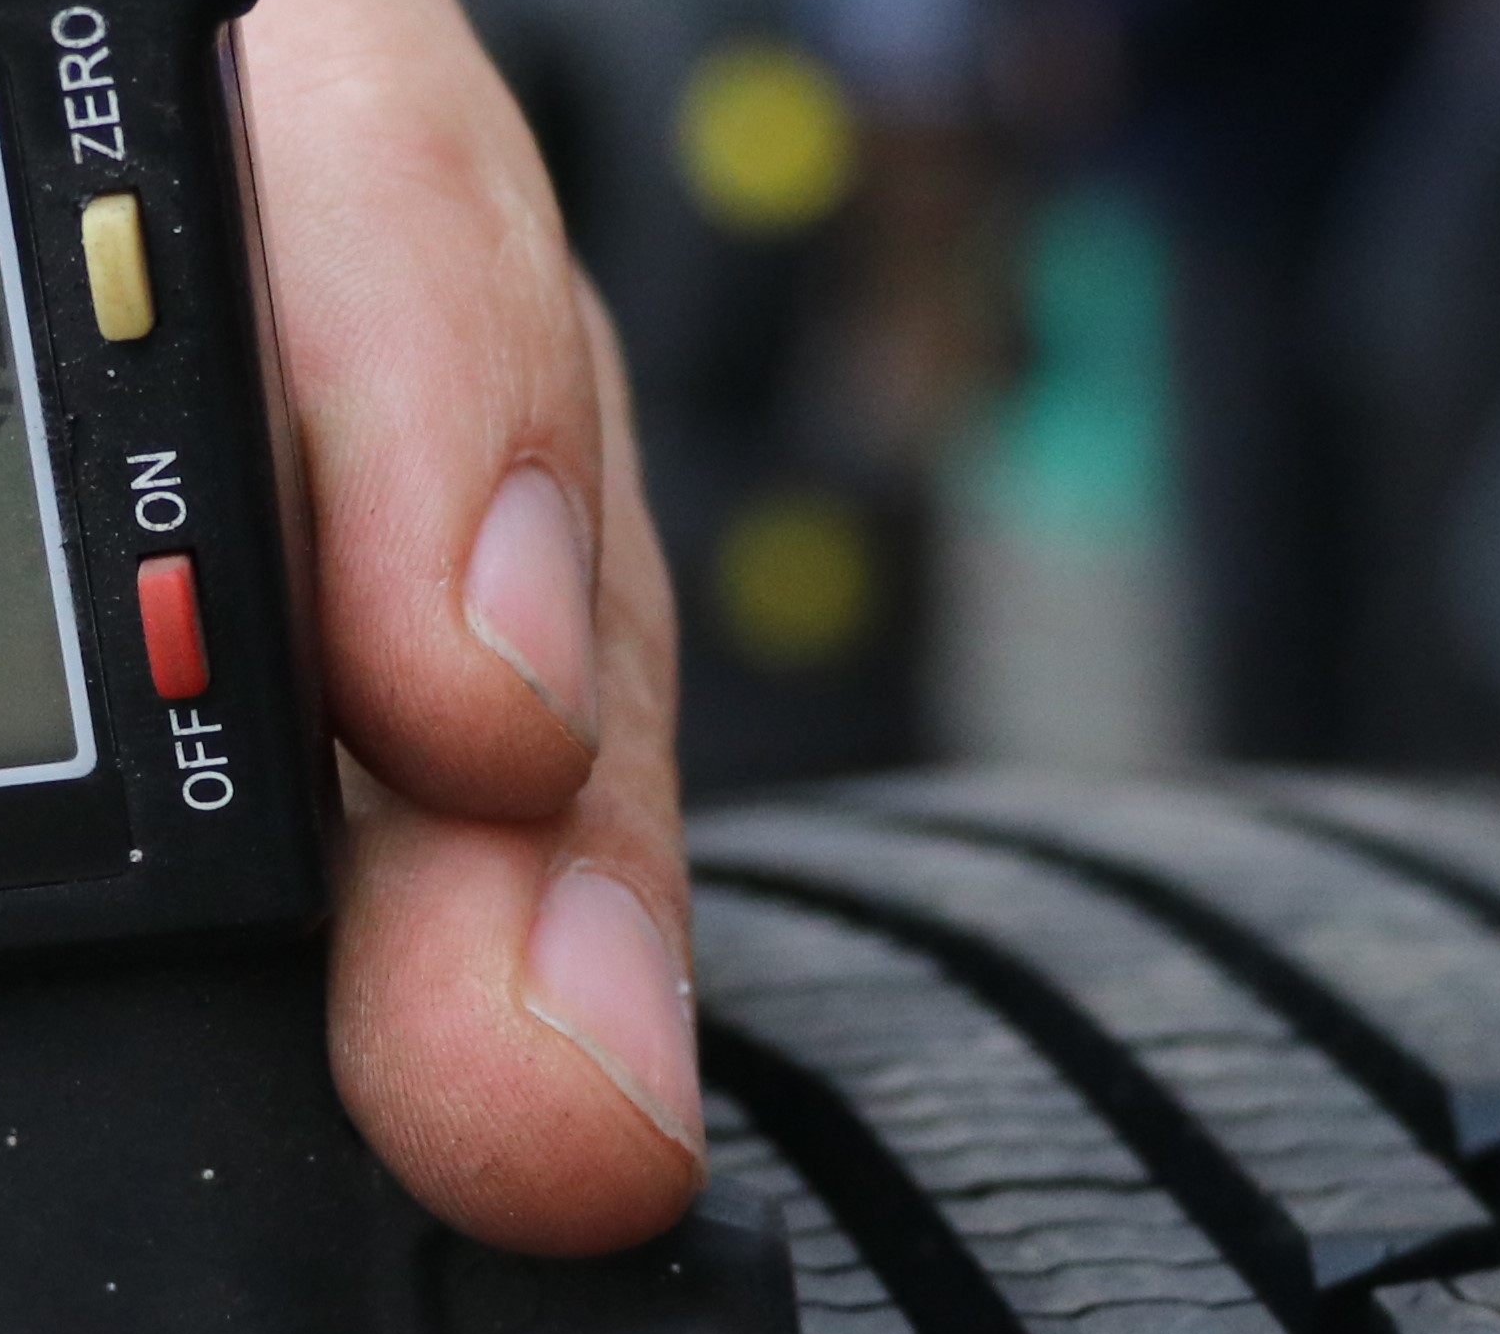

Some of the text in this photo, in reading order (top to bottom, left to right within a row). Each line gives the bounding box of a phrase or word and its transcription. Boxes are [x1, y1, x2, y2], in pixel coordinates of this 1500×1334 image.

[50, 5, 125, 164] ZERO
[125, 450, 187, 533] ON
[168, 708, 234, 811] OFF
